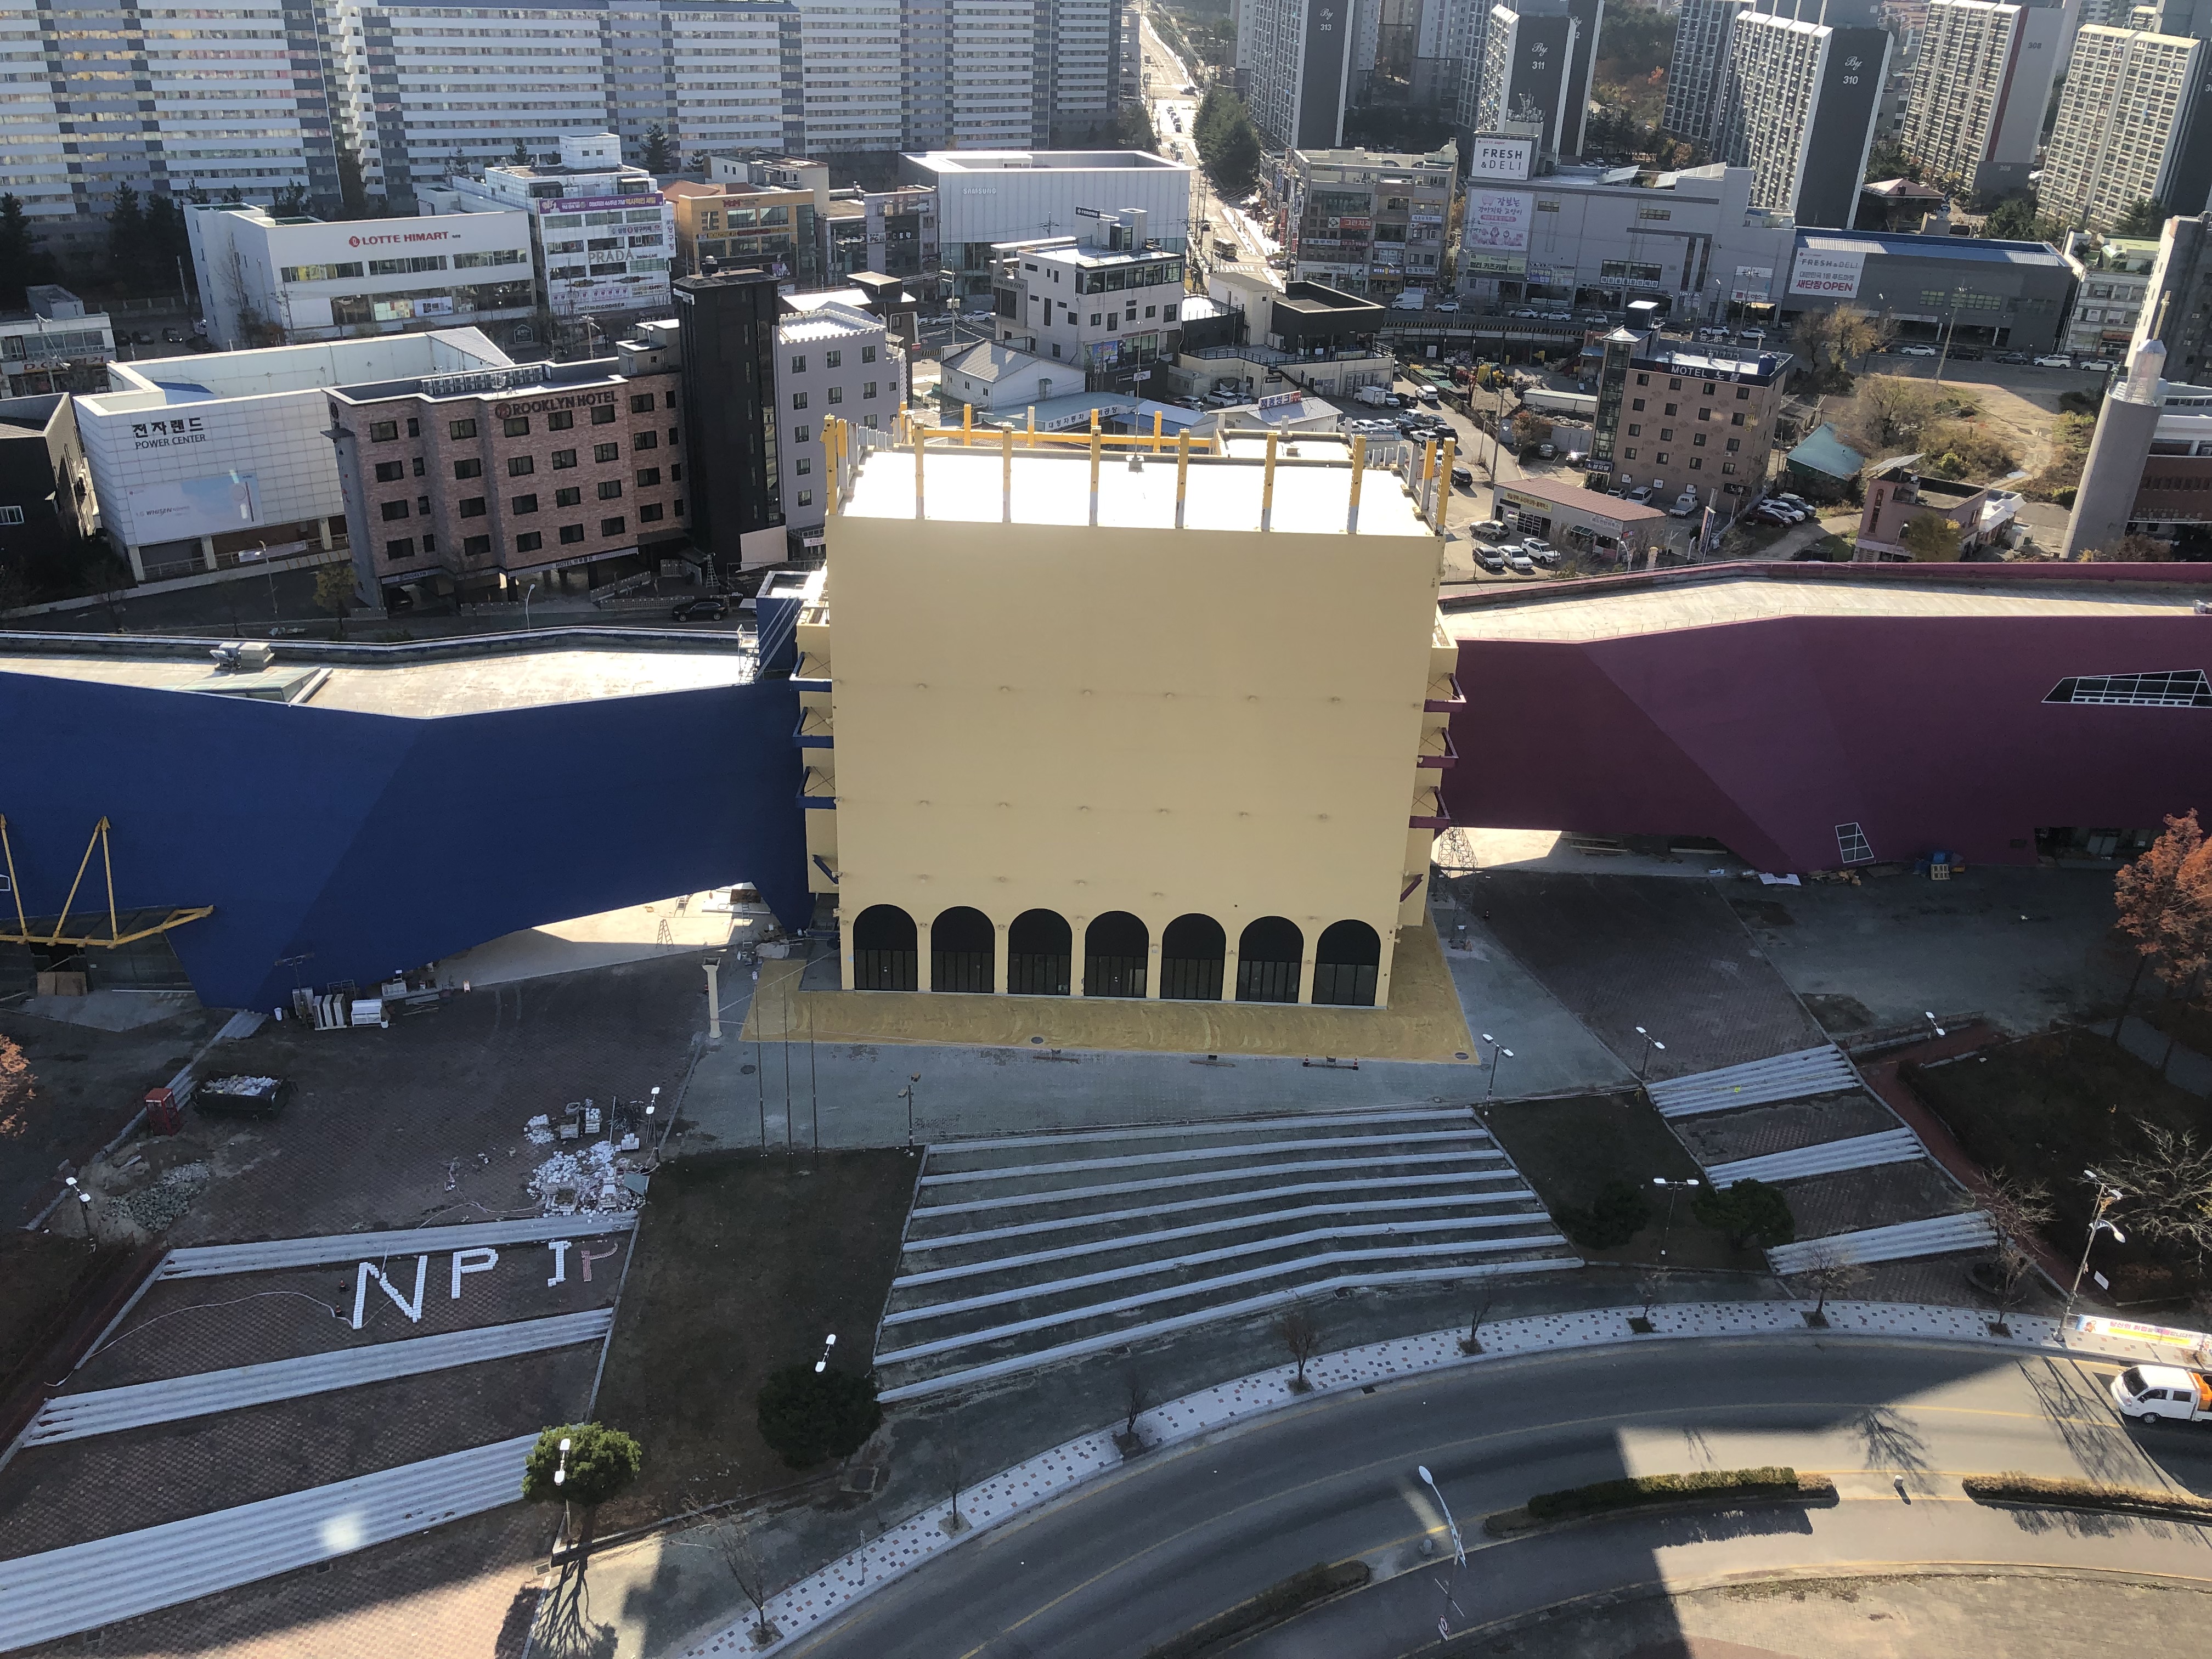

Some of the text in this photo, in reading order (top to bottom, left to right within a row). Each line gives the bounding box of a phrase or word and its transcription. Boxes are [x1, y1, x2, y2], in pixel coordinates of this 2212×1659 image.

[1320, 8, 1334, 20] By
[1531, 42, 1548, 57] By
[1532, 61, 1545, 70] 311
[1844, 55, 1863, 71] By
[1843, 75, 1859, 84] 310
[1482, 148, 1522, 160] FRESH
[1497, 196, 1520, 207] 장보는
[1477, 206, 1502, 215] 강아지와
[362, 231, 449, 245] LOTTE HIMART
[588, 248, 635, 264] PRADA
[1796, 279, 1853, 291] 새단장 OPEN
[1671, 365, 1707, 378] MOTEL
[578, 390, 619, 407] HOTEL
[132, 417, 204, 438] 전자랜드
[135, 433, 206, 450] POWER CENTER
[556, 560, 573, 568] HOTEL
